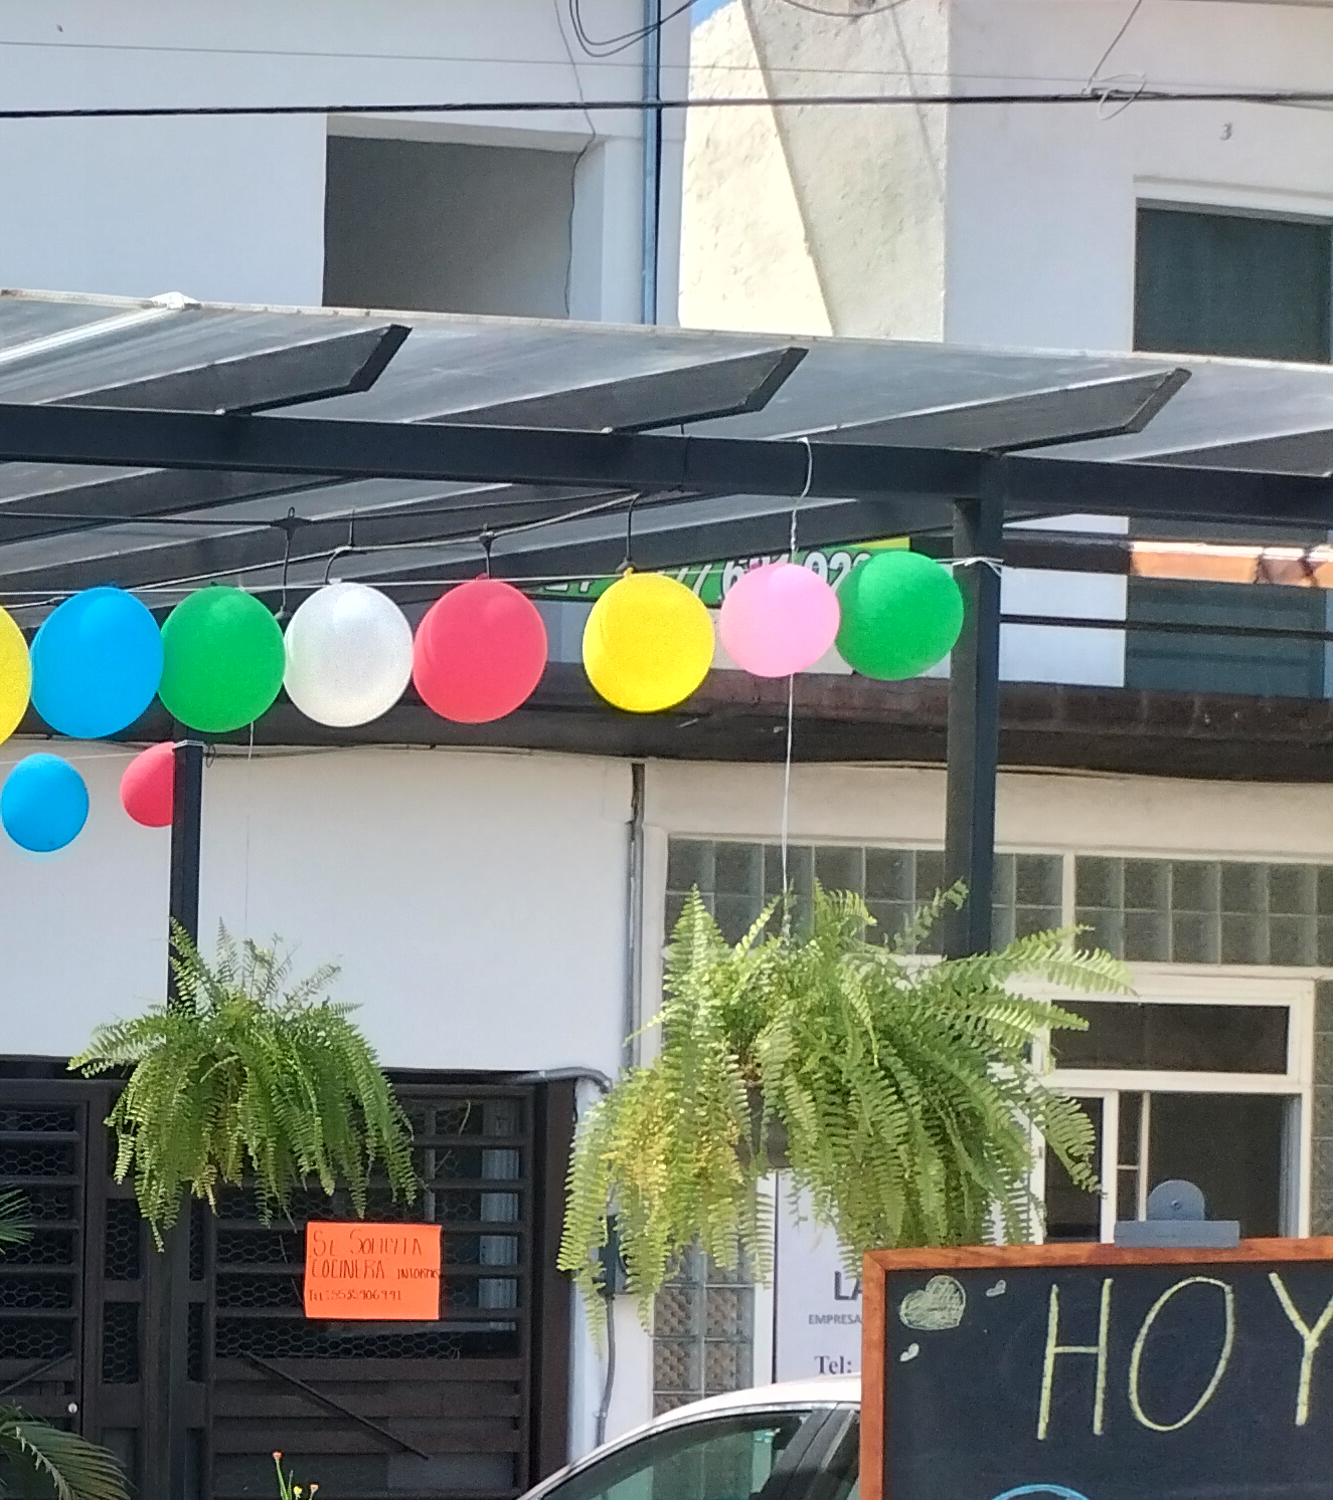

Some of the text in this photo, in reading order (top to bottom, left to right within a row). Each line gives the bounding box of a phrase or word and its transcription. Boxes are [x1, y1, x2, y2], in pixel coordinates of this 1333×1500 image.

[311, 1259, 385, 1279] COCINERA
[808, 1313, 863, 1325] EMPRESA
[814, 1355, 852, 1375] Tel:
[1037, 1272, 1333, 1440] HOY
